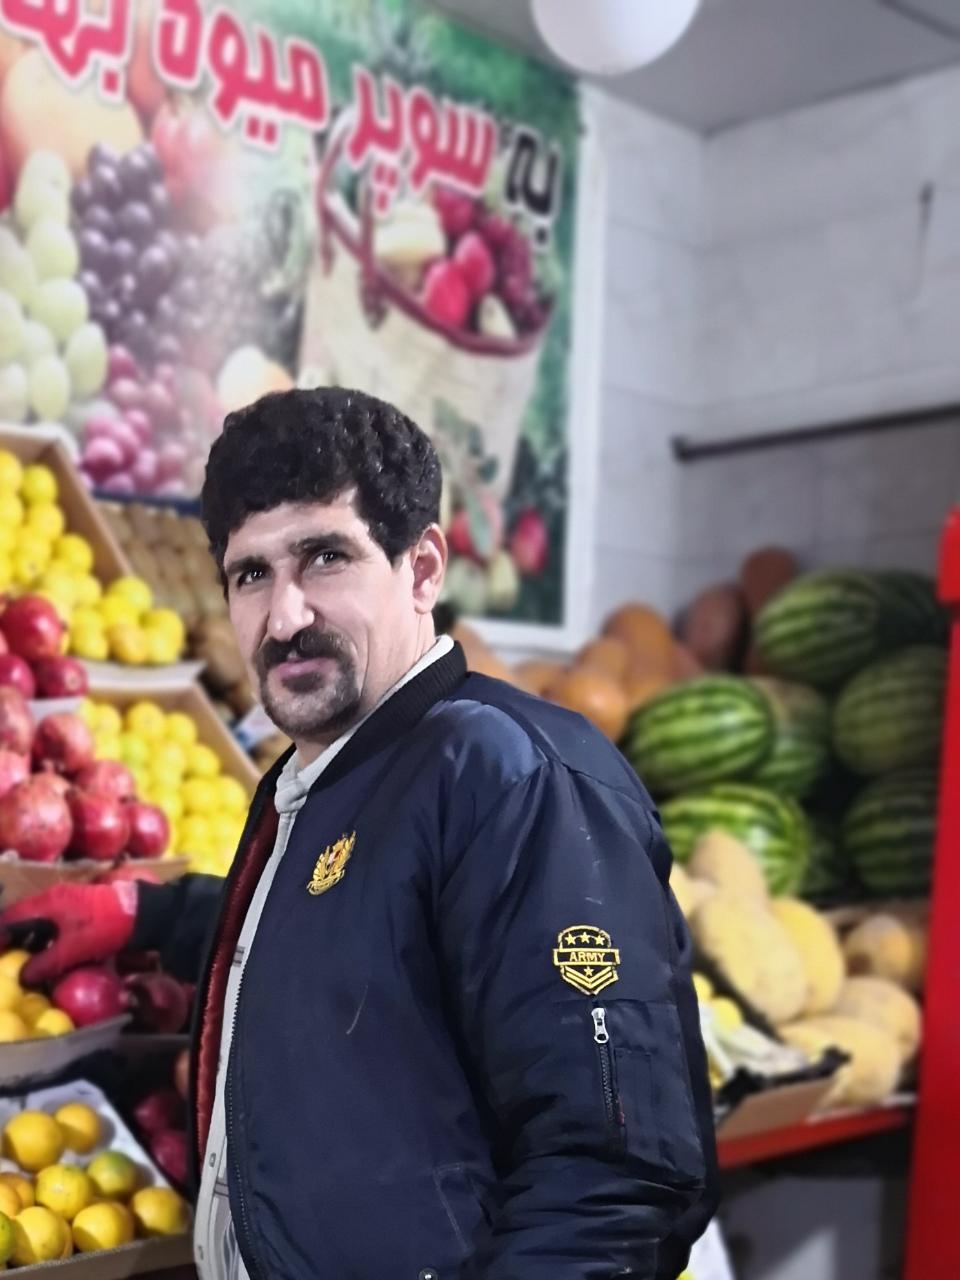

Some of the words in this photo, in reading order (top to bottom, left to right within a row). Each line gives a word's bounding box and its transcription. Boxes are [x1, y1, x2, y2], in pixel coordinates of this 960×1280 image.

[158, 0, 327, 144] میوه
[348, 70, 497, 212] سوپر
[569, 951, 605, 962] ARMY
